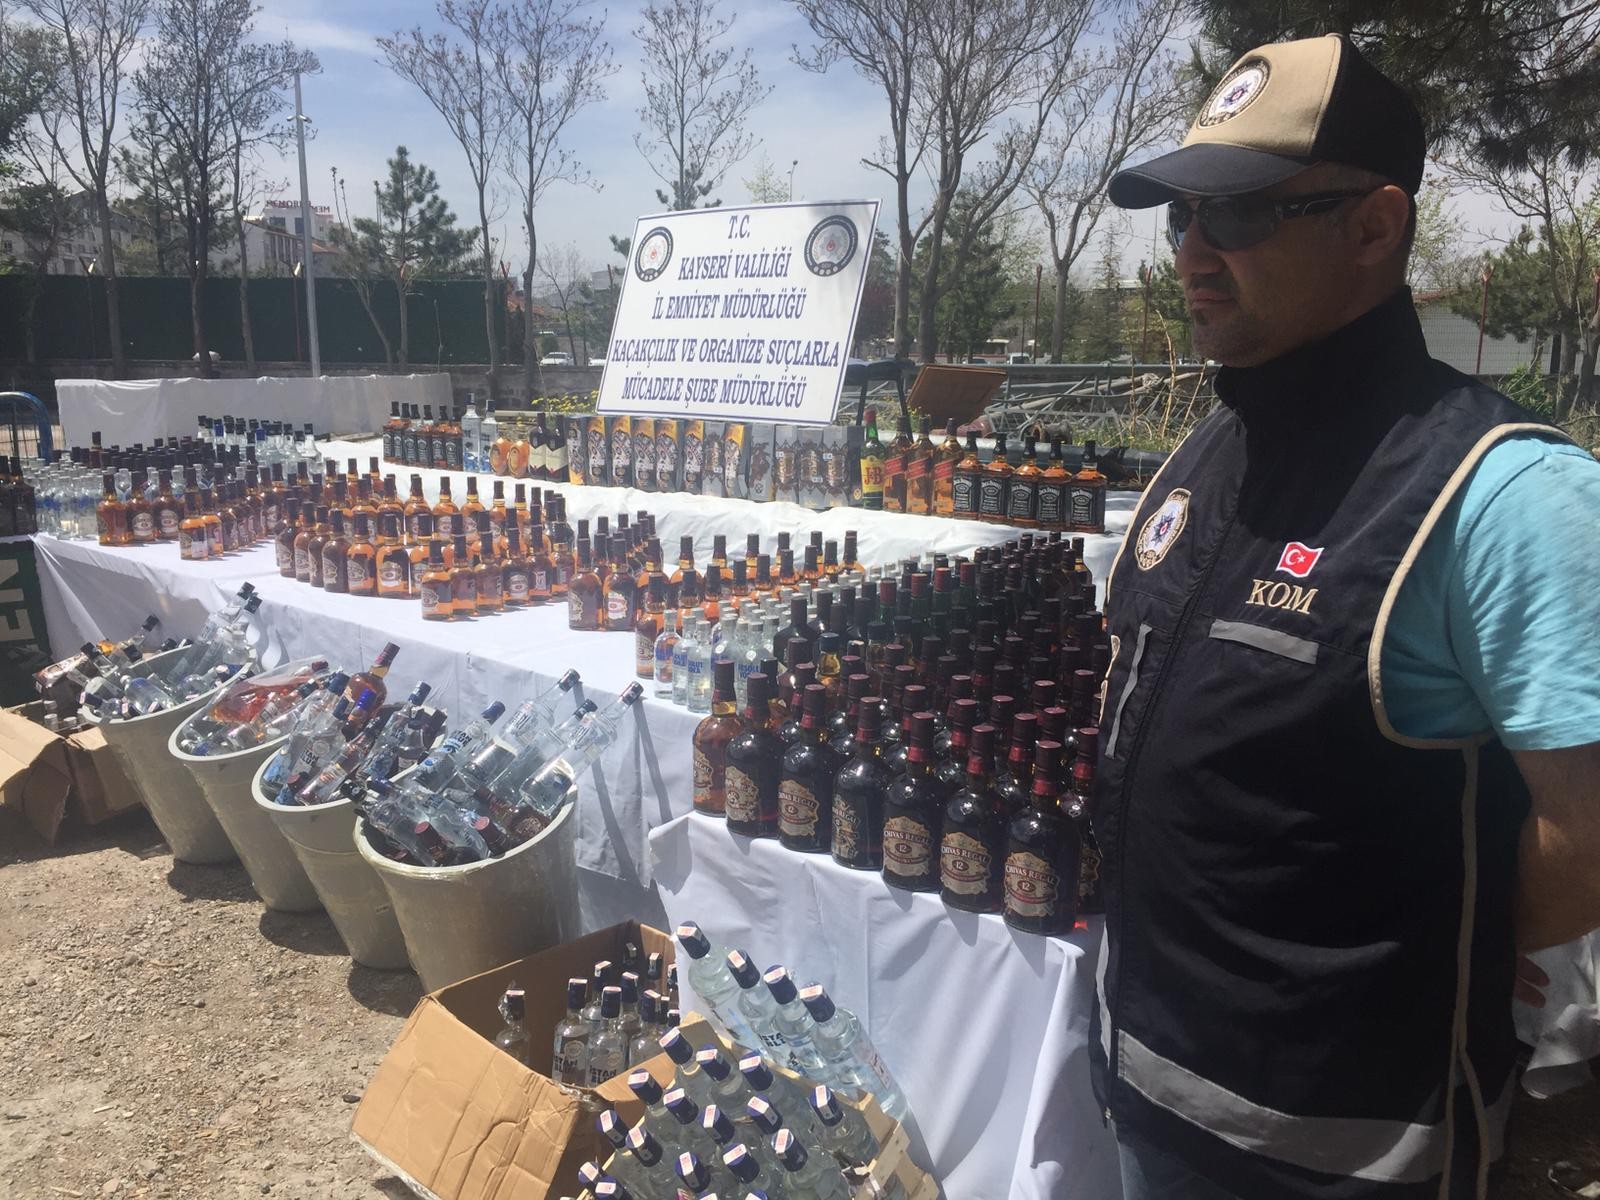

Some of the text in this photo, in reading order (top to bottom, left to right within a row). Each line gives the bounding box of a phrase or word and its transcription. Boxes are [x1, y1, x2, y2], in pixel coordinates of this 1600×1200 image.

[728, 214, 750, 239] T.C.
[678, 248, 733, 281] KAYSERİ
[735, 246, 792, 278] VALİLİĞİ
[652, 287, 807, 320] İL EMNİYET MÜDÜRLÜĞÜ
[611, 332, 839, 373] KAÇAKÇILIK VE ORGANİZE SUÇLARLA
[621, 371, 807, 409] MÜCADELE ŞUBE MÜDÜRLÜĞÜ
[1245, 579, 1319, 615] KOM
[899, 843, 907, 852] 12
[961, 849, 987, 863] REGAL
[956, 861, 964, 870] 12
[1028, 869, 1056, 884] REGAL
[1022, 880, 1030, 890] 12
